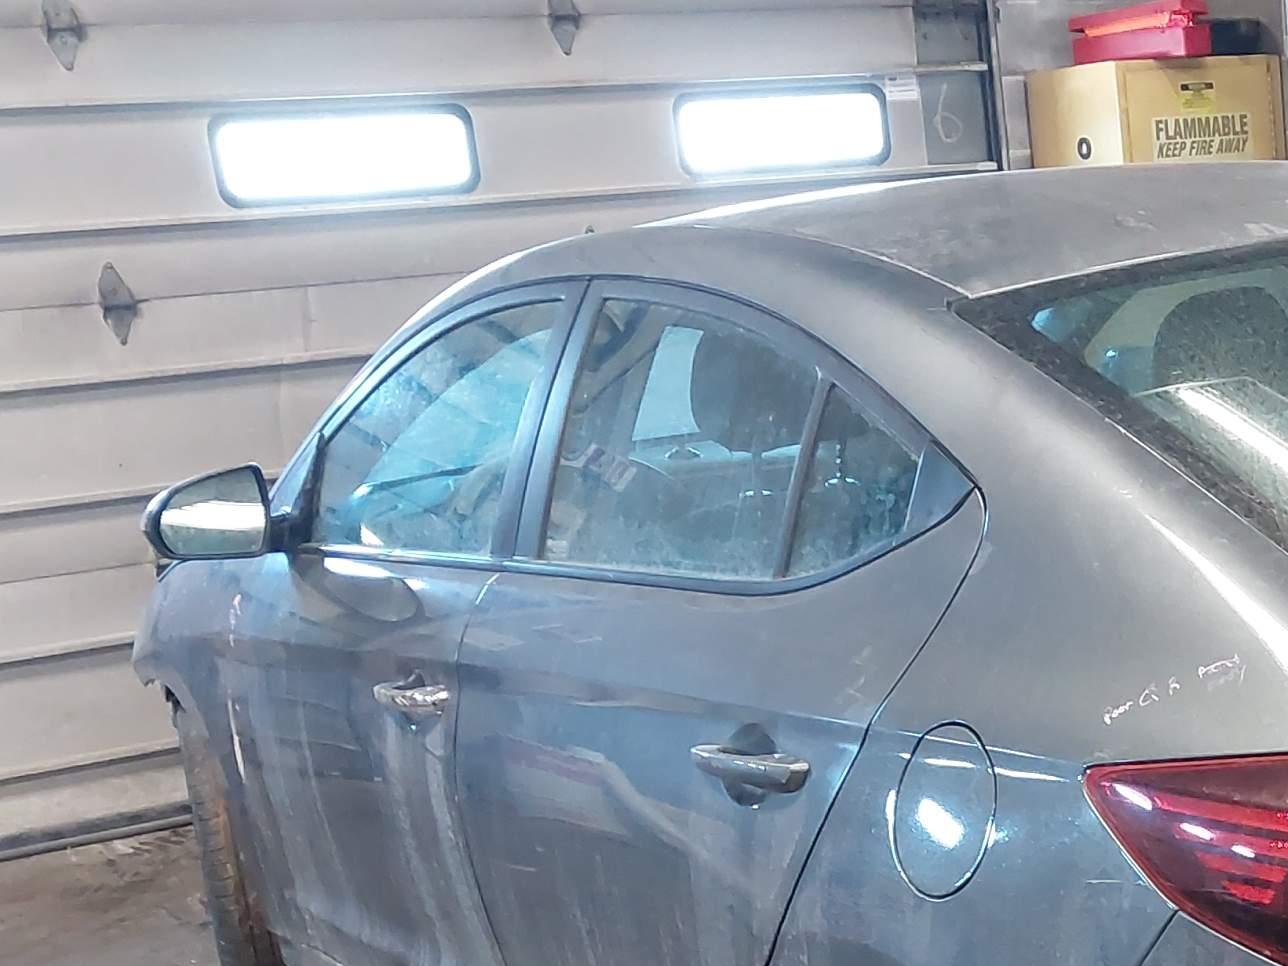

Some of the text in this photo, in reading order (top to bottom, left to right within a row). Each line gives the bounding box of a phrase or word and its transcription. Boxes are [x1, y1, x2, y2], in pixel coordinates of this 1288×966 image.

[1155, 113, 1249, 142] FLAMMABLE
[1157, 136, 1249, 159] KEEP FIRE AWAY
